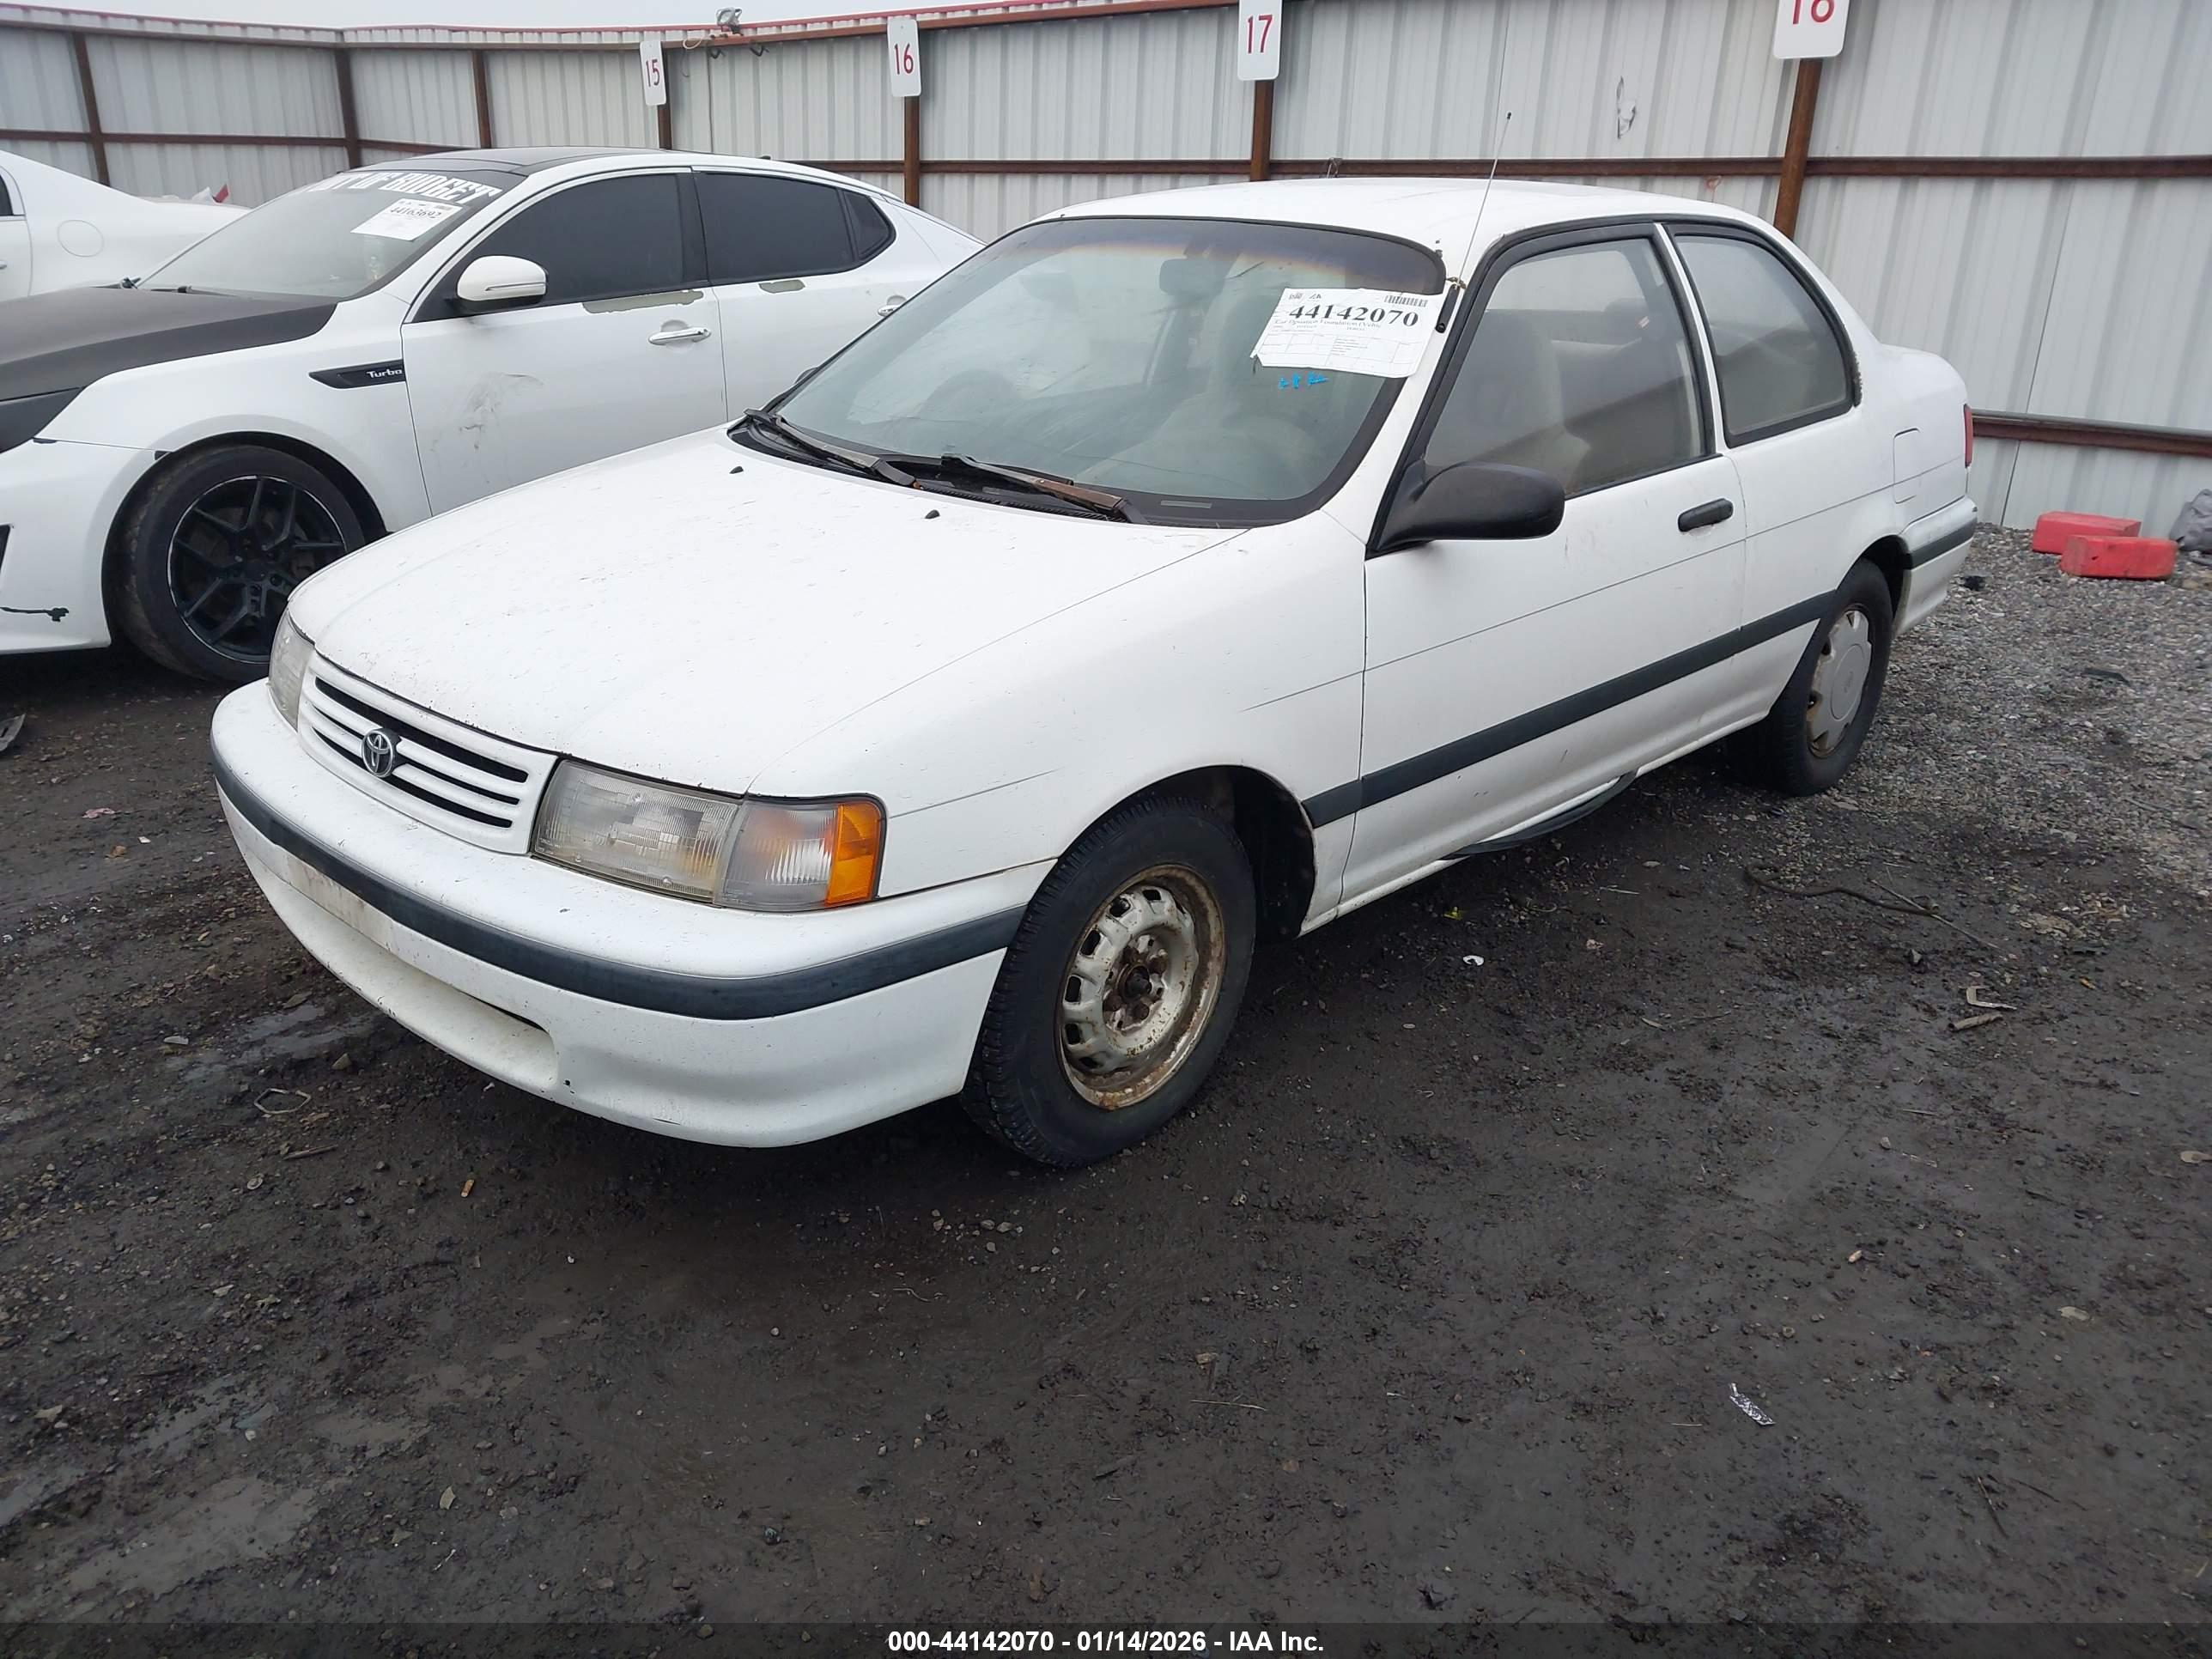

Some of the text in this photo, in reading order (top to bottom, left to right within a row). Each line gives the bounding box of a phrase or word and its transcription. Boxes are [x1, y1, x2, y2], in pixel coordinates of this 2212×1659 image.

[1248, 14, 1273, 54] 17
[645, 58, 660, 87] 15
[893, 43, 915, 76] 16
[379, 173, 503, 204] BUDGET
[1289, 304, 1419, 327] 44142070
[367, 369, 403, 379] Turbo
